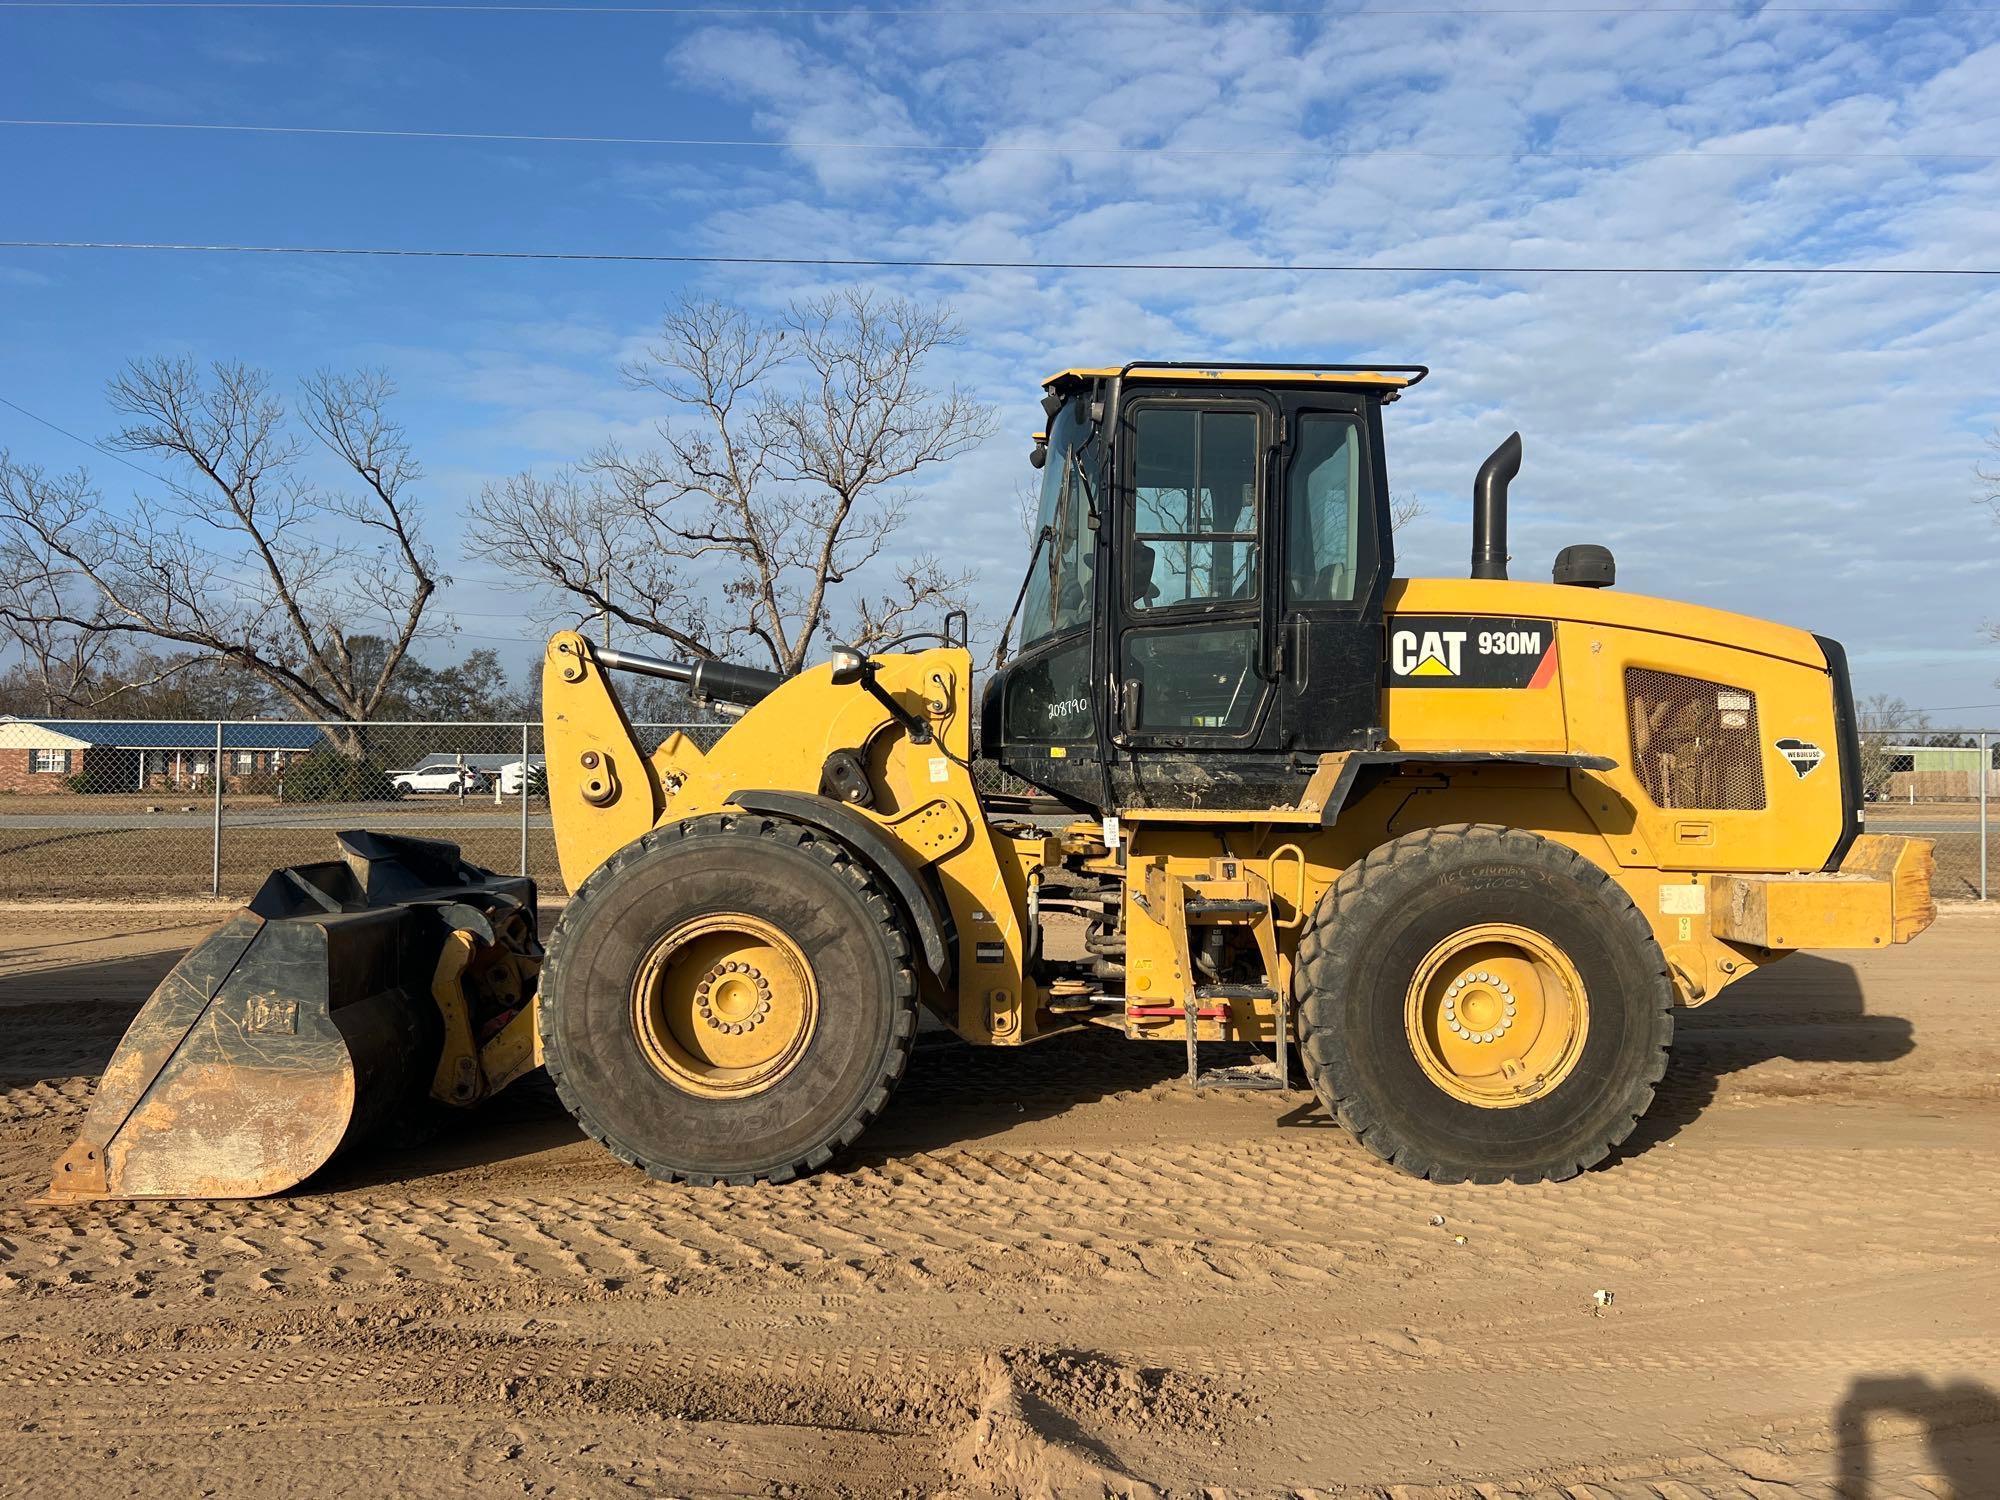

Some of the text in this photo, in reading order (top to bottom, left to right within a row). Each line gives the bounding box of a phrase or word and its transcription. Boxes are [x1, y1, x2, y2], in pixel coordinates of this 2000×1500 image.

[1392, 630, 1541, 676] CAT 930M
[1047, 698, 1087, 720] 208790
